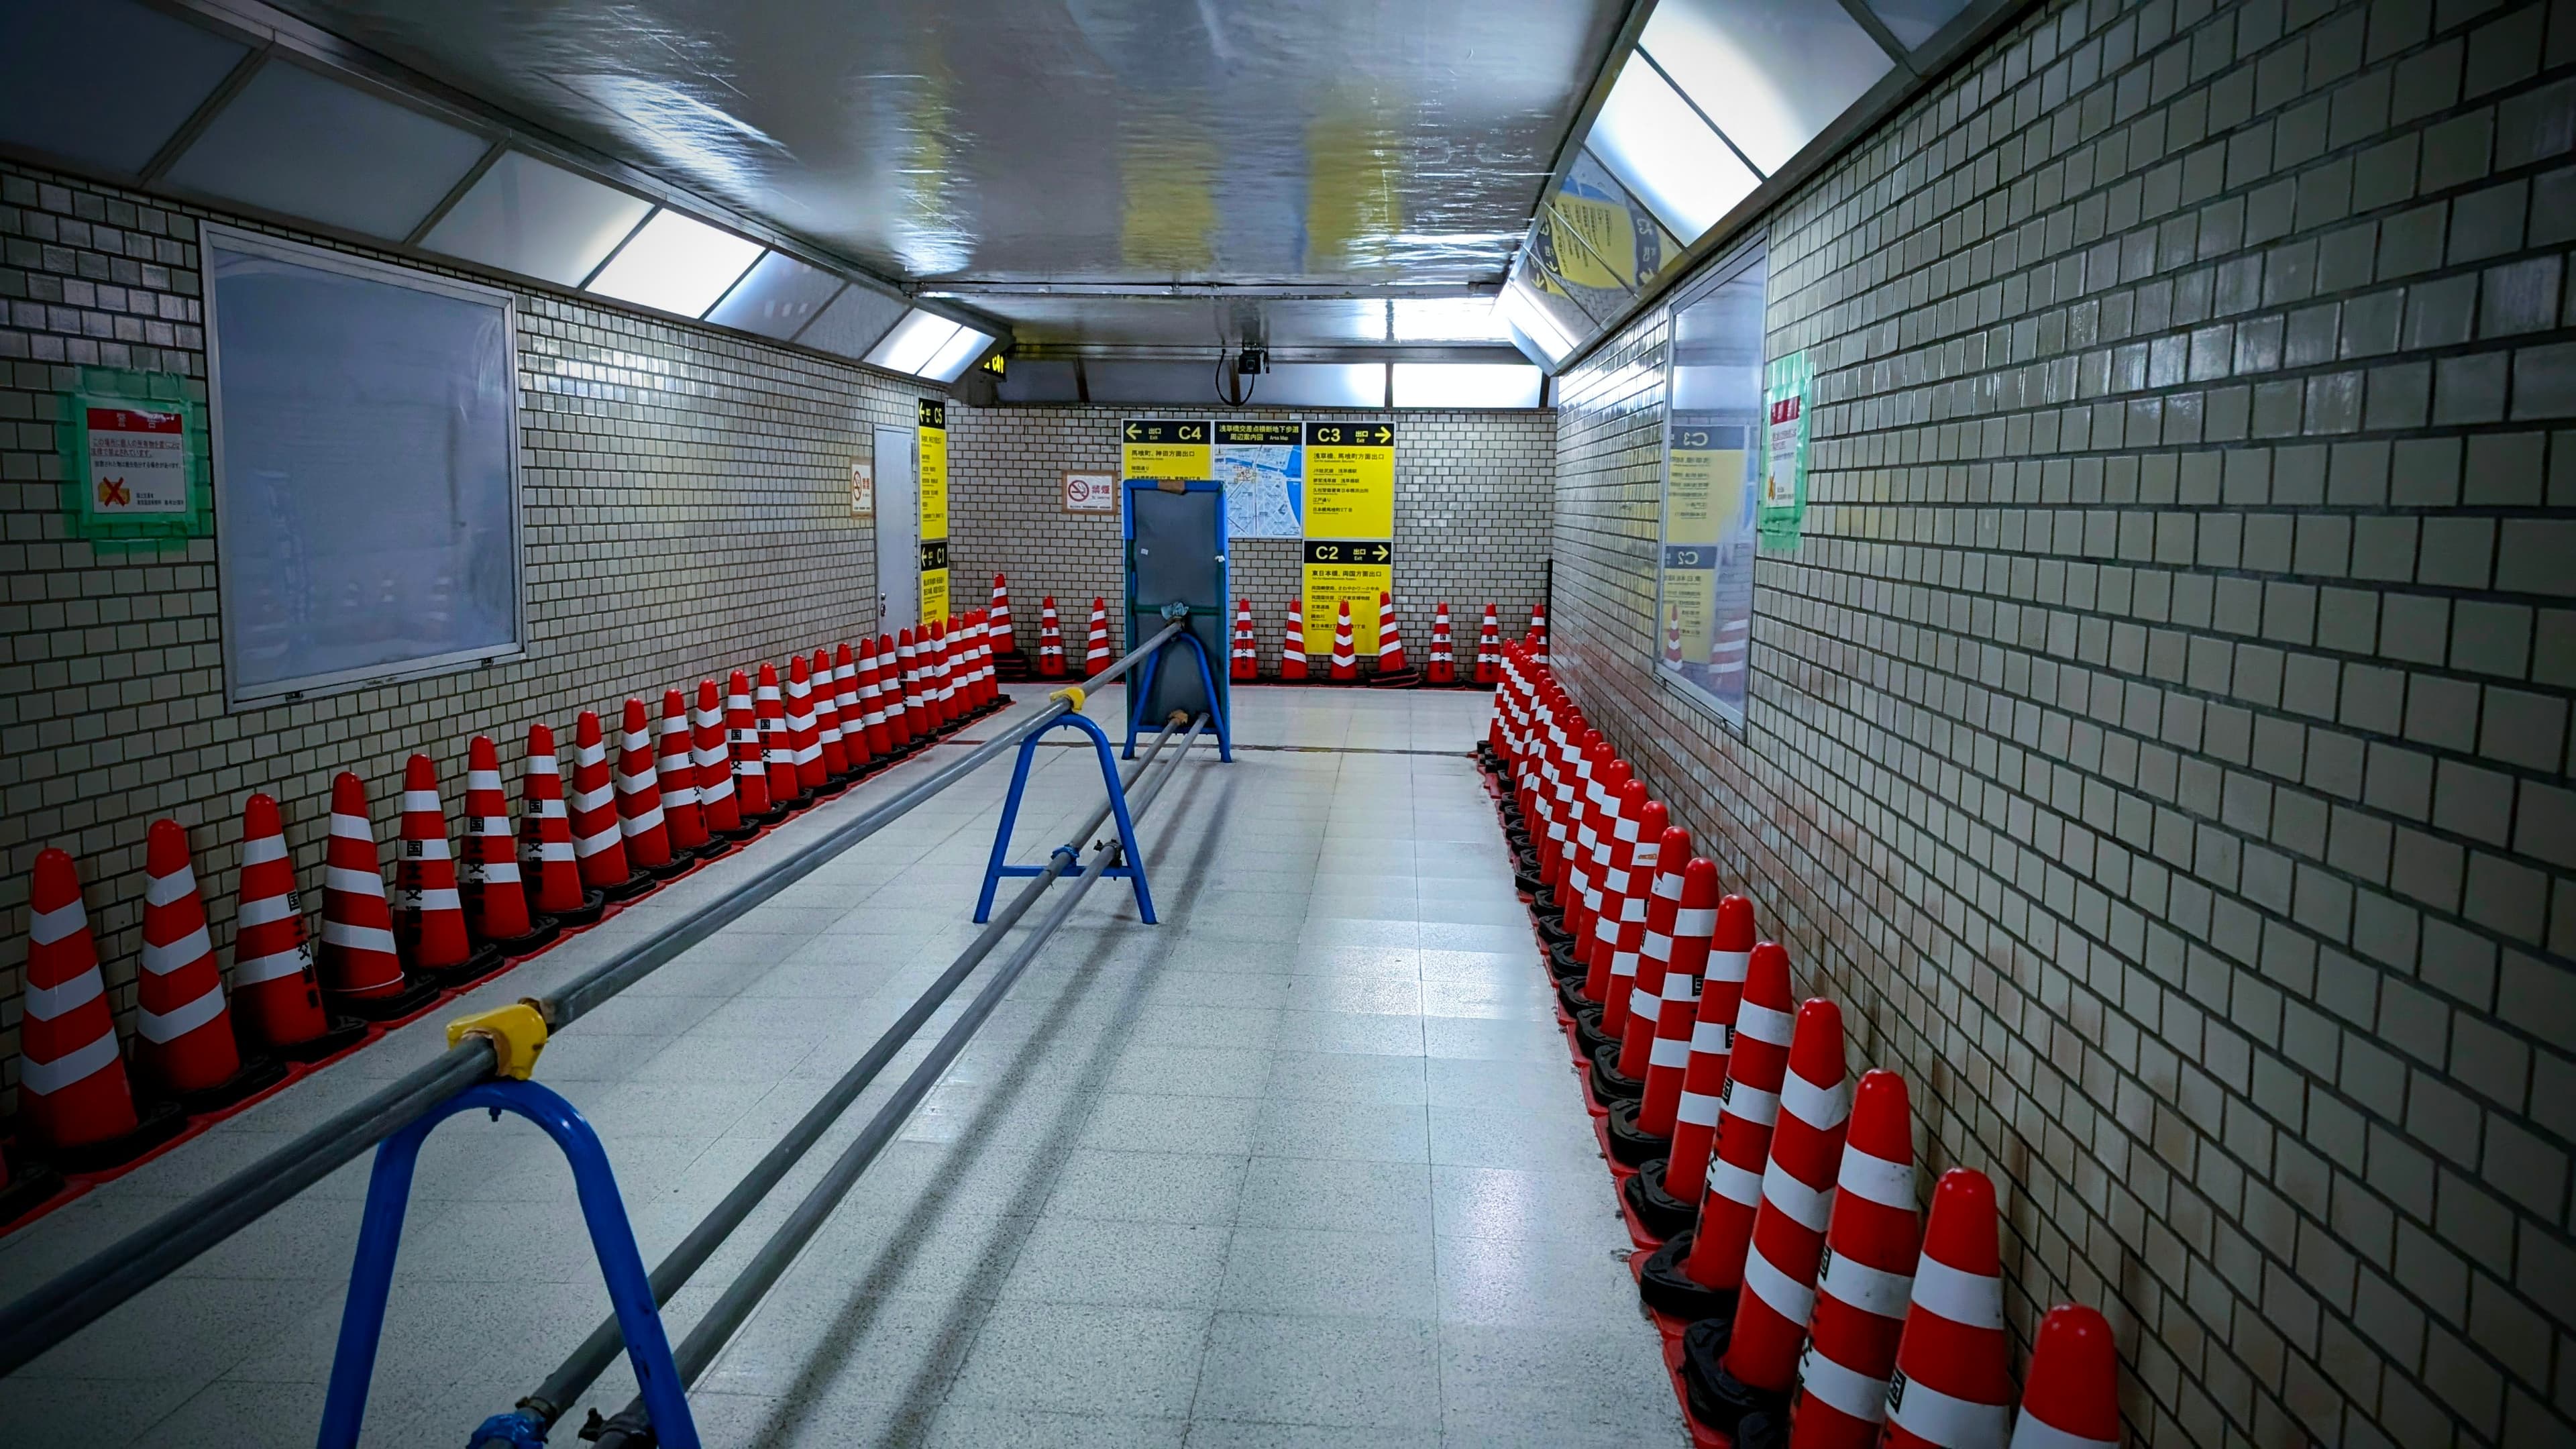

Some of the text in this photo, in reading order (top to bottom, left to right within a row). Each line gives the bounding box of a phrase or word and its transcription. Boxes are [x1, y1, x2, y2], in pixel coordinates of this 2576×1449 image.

[934, 407, 943, 424] C5
[1179, 426, 1201, 440] C4
[1318, 428, 1340, 442] C3
[1092, 485, 1110, 494] 禁煙
[937, 547, 945, 564] C1
[1316, 546, 1338, 559] C2
